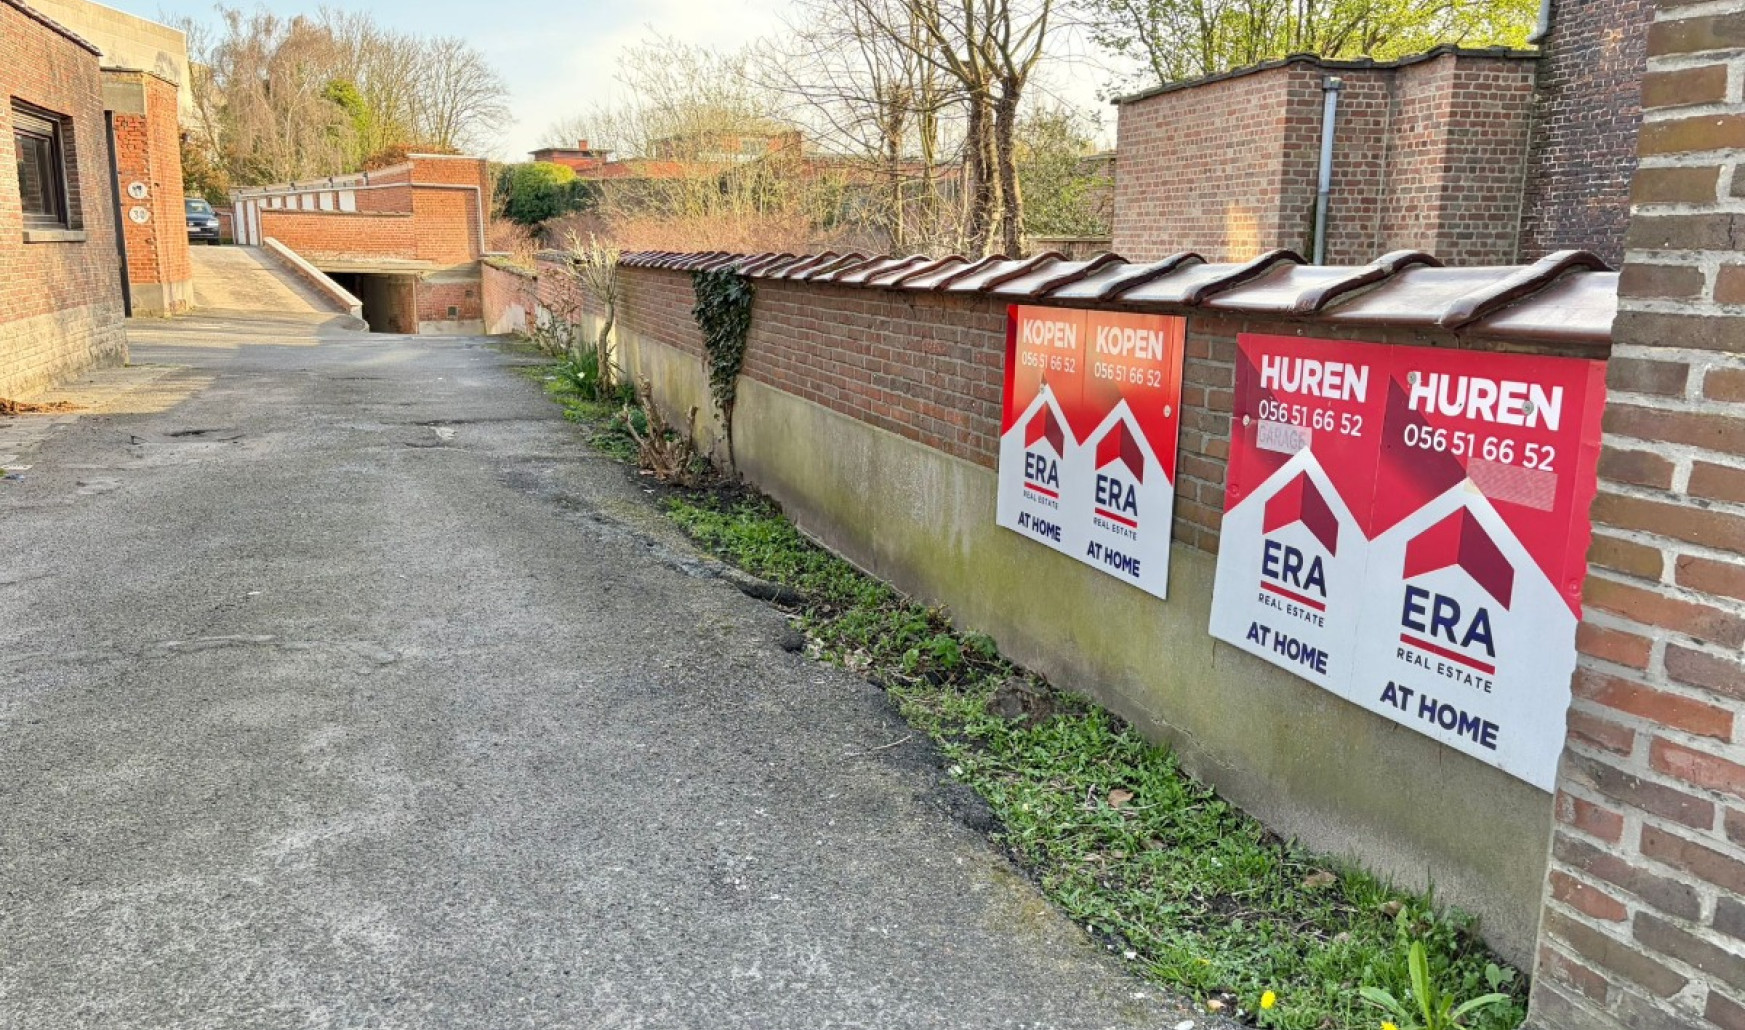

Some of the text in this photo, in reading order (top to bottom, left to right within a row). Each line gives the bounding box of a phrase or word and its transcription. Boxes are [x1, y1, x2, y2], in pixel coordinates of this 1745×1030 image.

[1023, 318, 1077, 349] KOPEN
[1096, 325, 1164, 361] KOPEN
[1022, 351, 1076, 373] 056 51 66 52
[1094, 361, 1161, 388] 056 51 66 52
[1260, 354, 1370, 403] HUREN
[1259, 399, 1363, 437] 056 51 66 52
[1407, 371, 1564, 431] HUREN
[1404, 423, 1556, 472] 056 51 66 52
[1024, 451, 1060, 489] ERA
[1023, 489, 1058, 511] REAL ESTATE
[1095, 473, 1138, 516] ERA
[1018, 511, 1061, 543] AT HOME
[1093, 517, 1137, 541] REAL ESTATE
[1087, 540, 1140, 578] AT HOME
[1261, 538, 1328, 598] ERA
[1258, 592, 1325, 628] REAL ESTATE
[1400, 584, 1496, 658] ERA
[1246, 621, 1329, 675] AT HOME
[1397, 647, 1493, 694] REAL ESTATE
[1379, 681, 1500, 750] AT HOME
